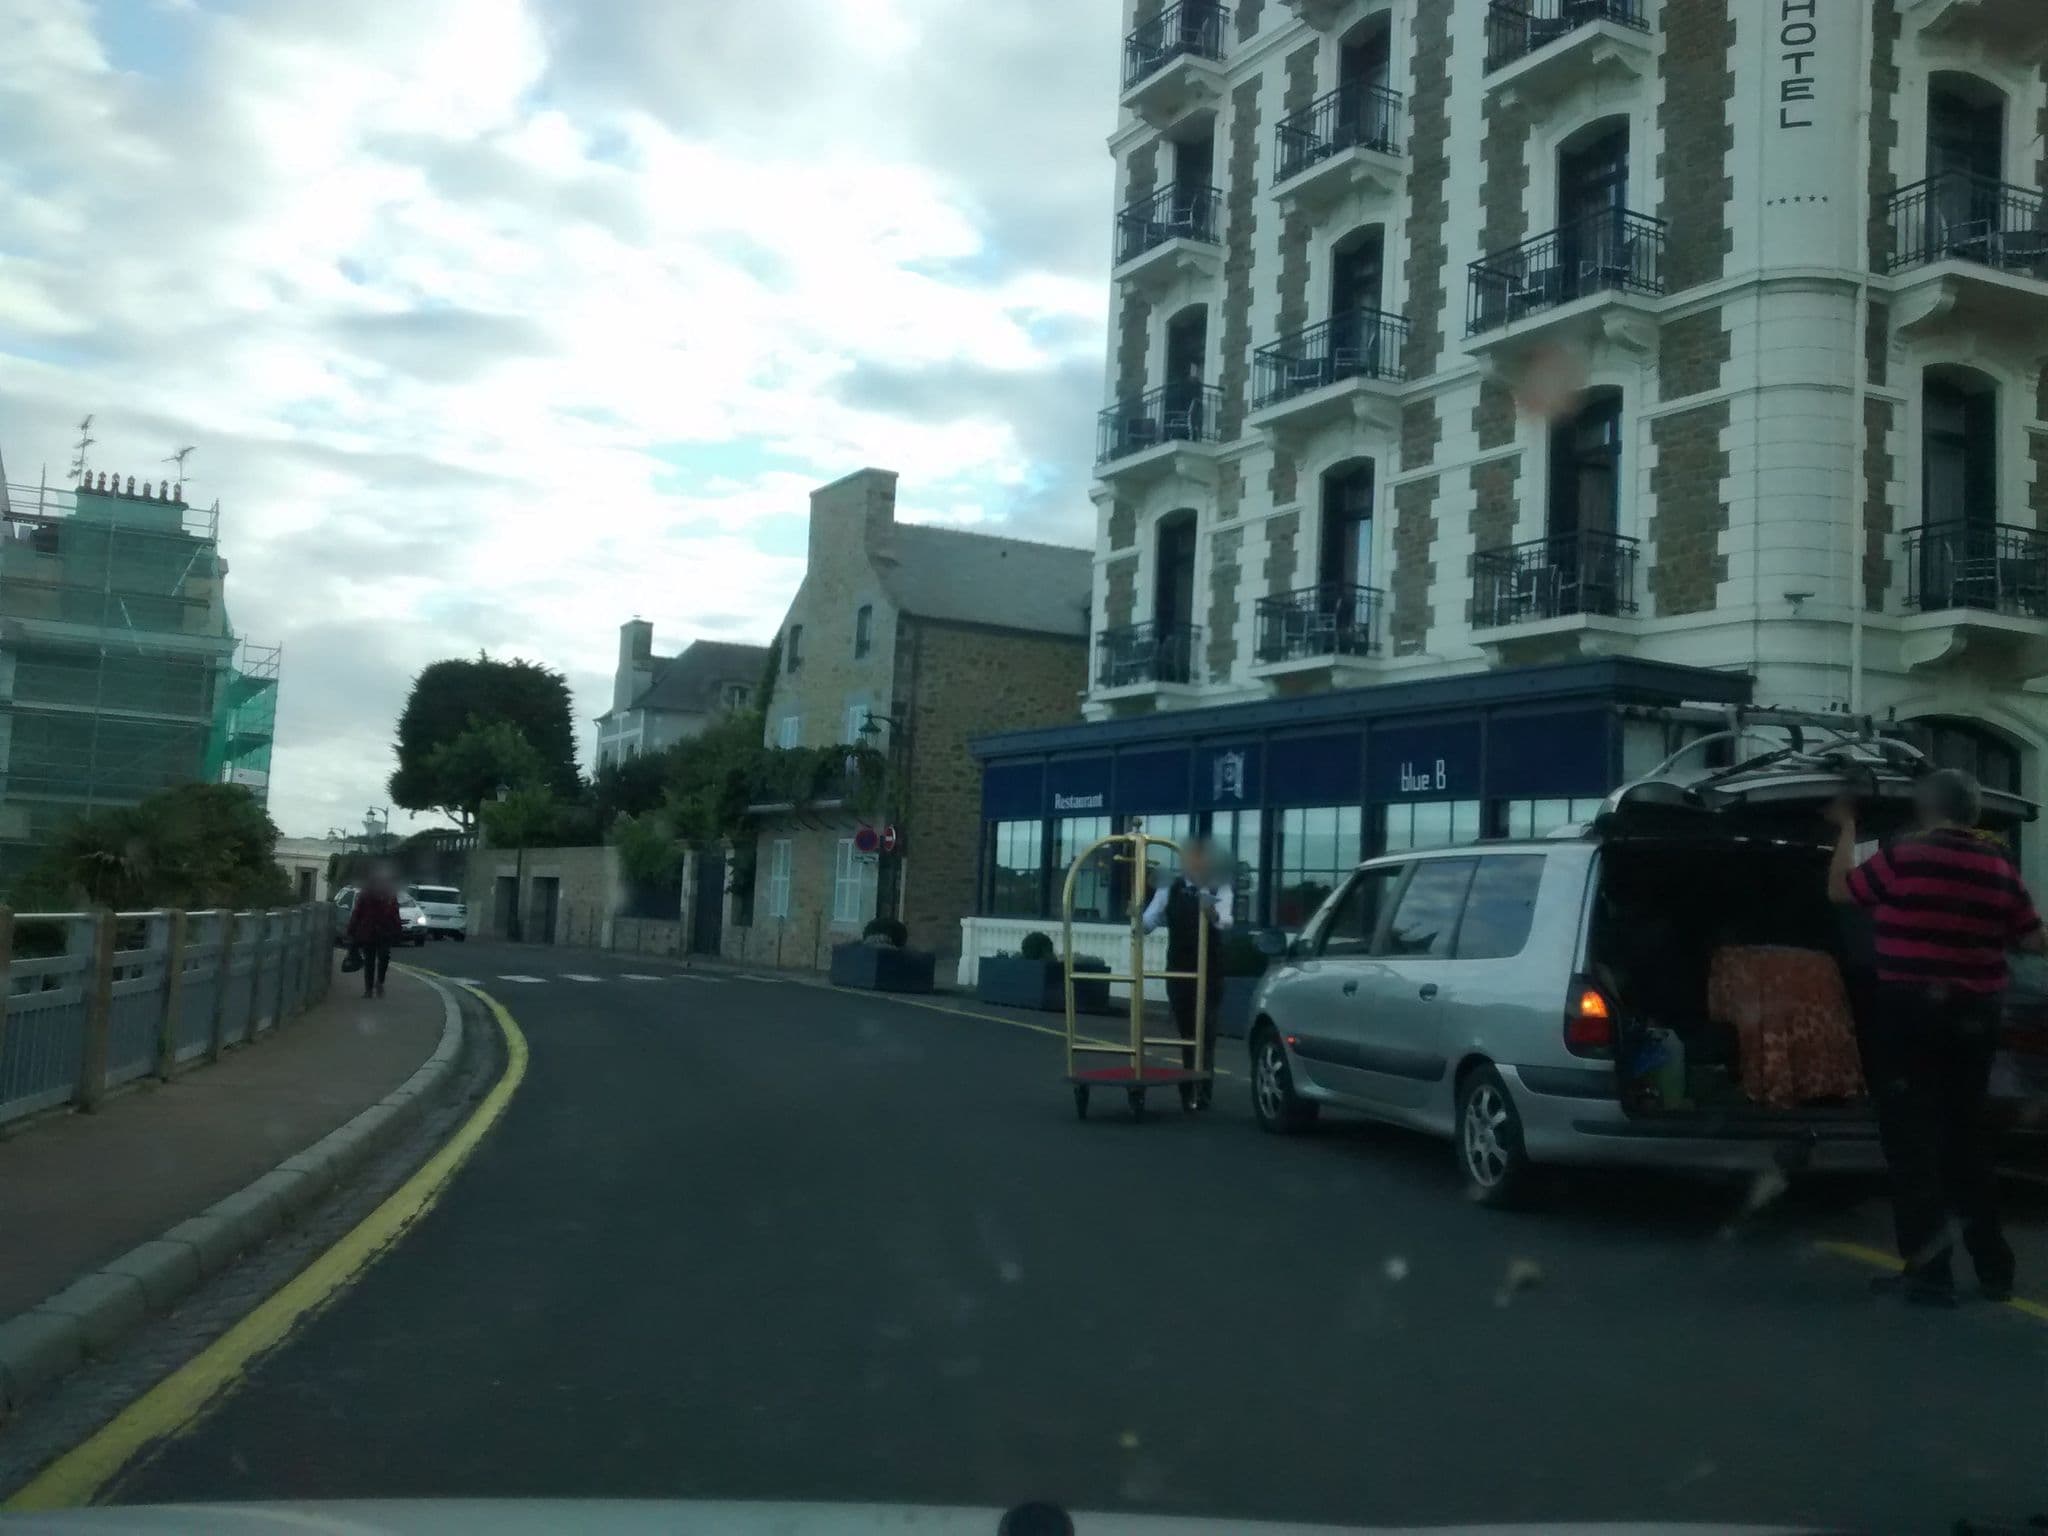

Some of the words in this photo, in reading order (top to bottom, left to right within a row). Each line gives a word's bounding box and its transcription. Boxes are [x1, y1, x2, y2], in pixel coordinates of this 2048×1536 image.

[1780, 0, 1816, 129] HOTEL
[1401, 762, 1430, 792] blue
[1436, 759, 1447, 790] B
[1054, 793, 1103, 809] Restaurant
